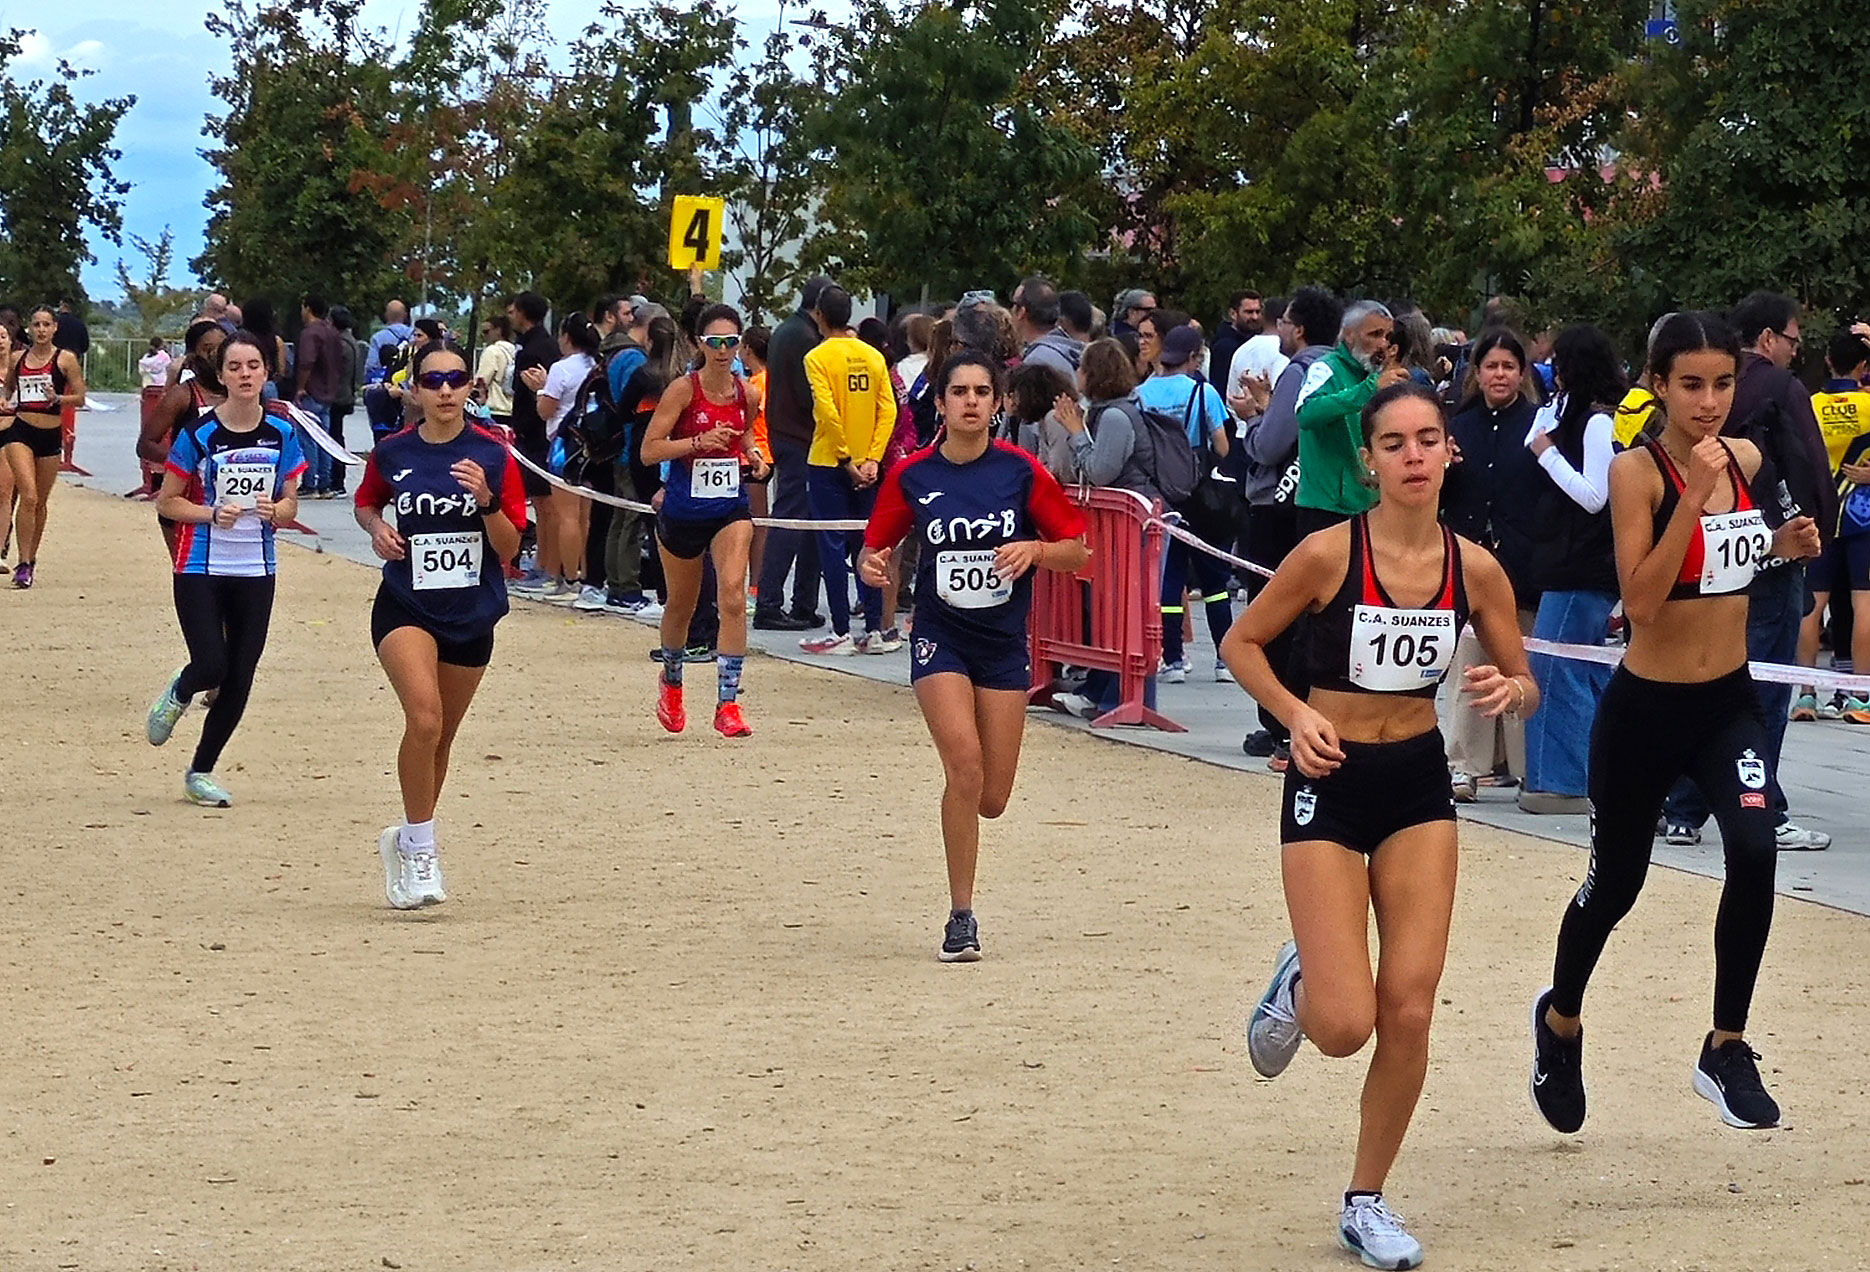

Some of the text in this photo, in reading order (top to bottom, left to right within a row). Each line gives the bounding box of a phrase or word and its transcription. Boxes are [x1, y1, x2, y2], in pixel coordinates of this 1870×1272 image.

[683, 209, 710, 262] 4
[1822, 404, 1857, 416] CLUB
[226, 477, 265, 495] 294
[700, 471, 731, 486] 161
[423, 548, 473, 572] 504
[1717, 533, 1765, 569] 103
[949, 567, 1001, 591] 505
[1358, 612, 1450, 627] C.A. SUANZES
[1368, 633, 1439, 667] 105
